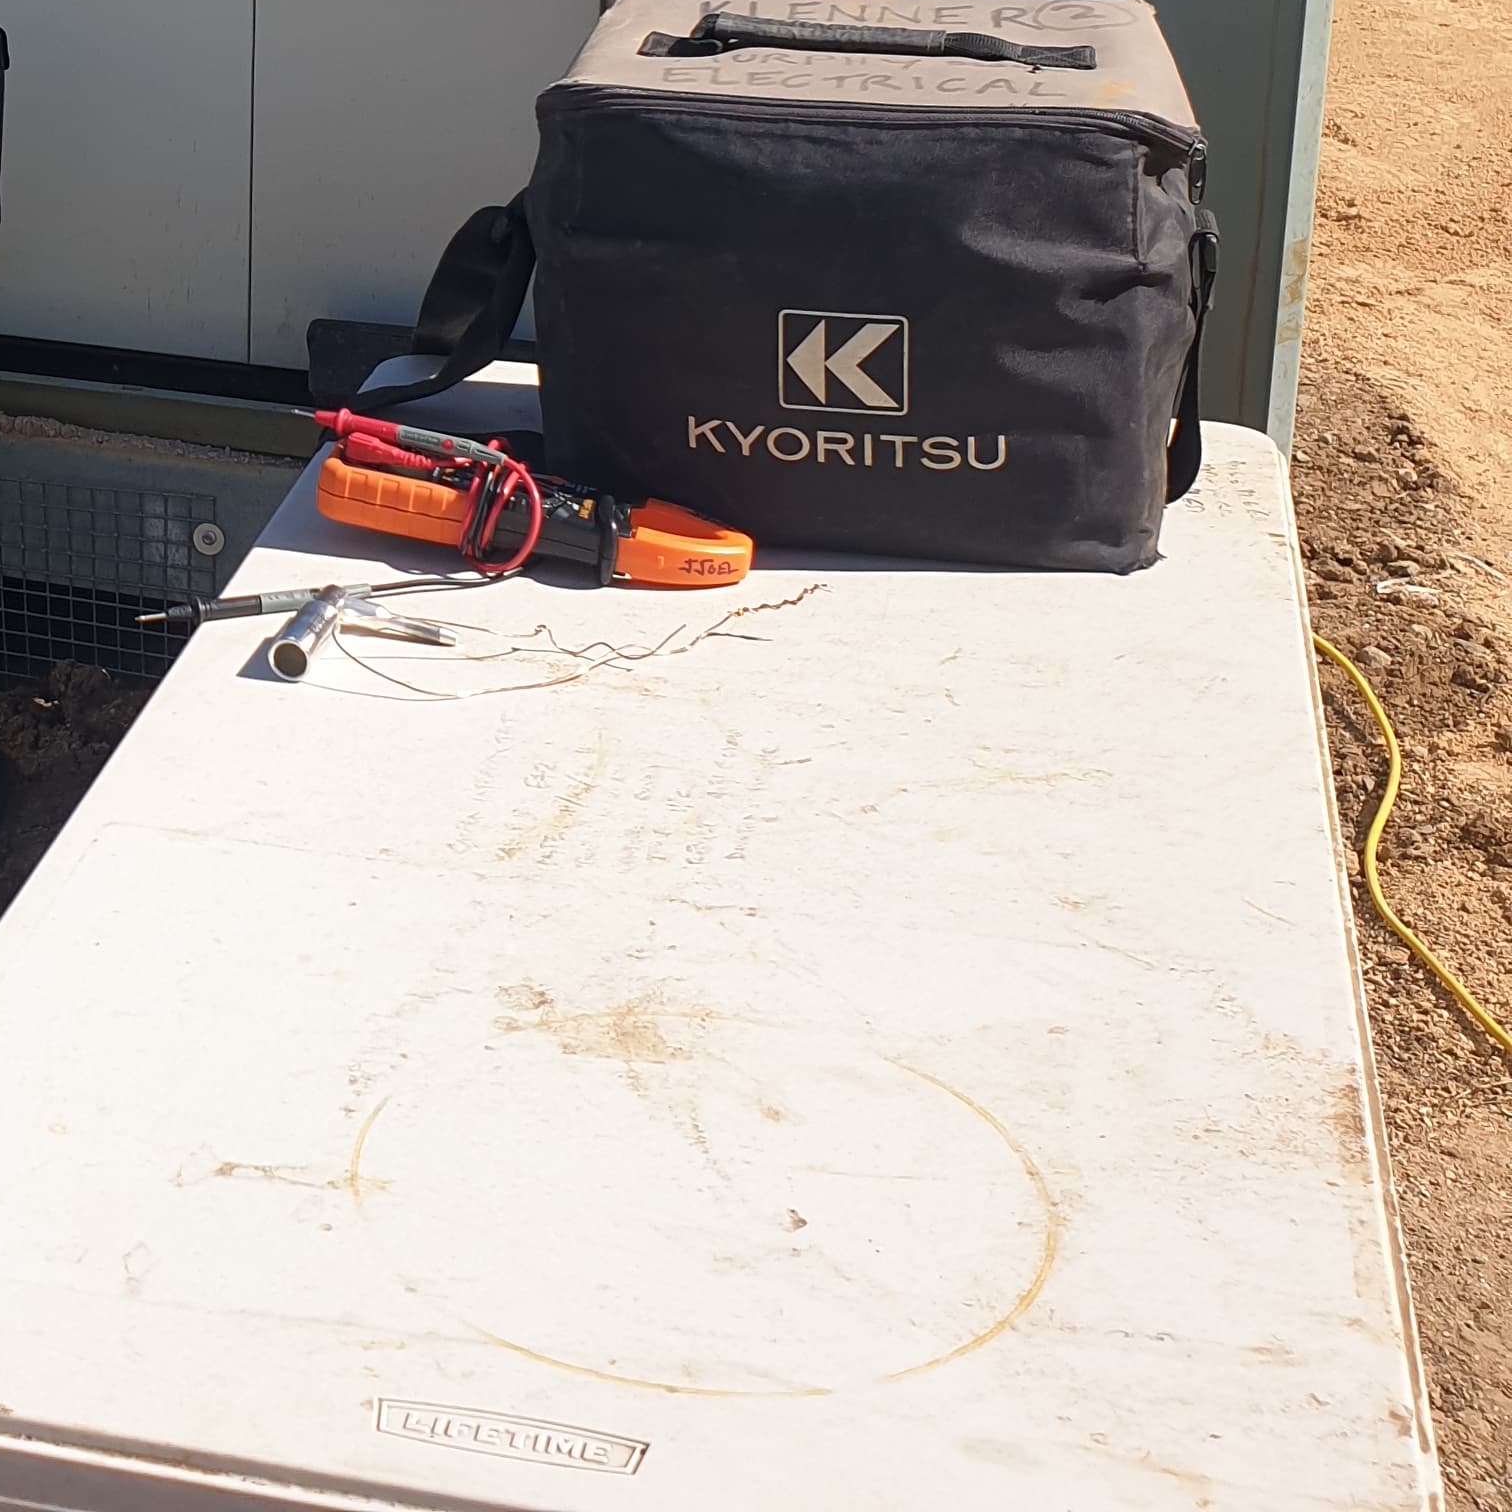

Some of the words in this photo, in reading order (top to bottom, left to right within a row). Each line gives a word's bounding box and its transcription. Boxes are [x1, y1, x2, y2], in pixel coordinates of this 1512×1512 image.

[662, 66, 1066, 97] ELECTRICAL
[688, 416, 1008, 470] KYORITSU
[402, 1412, 614, 1465] LIFETIME
